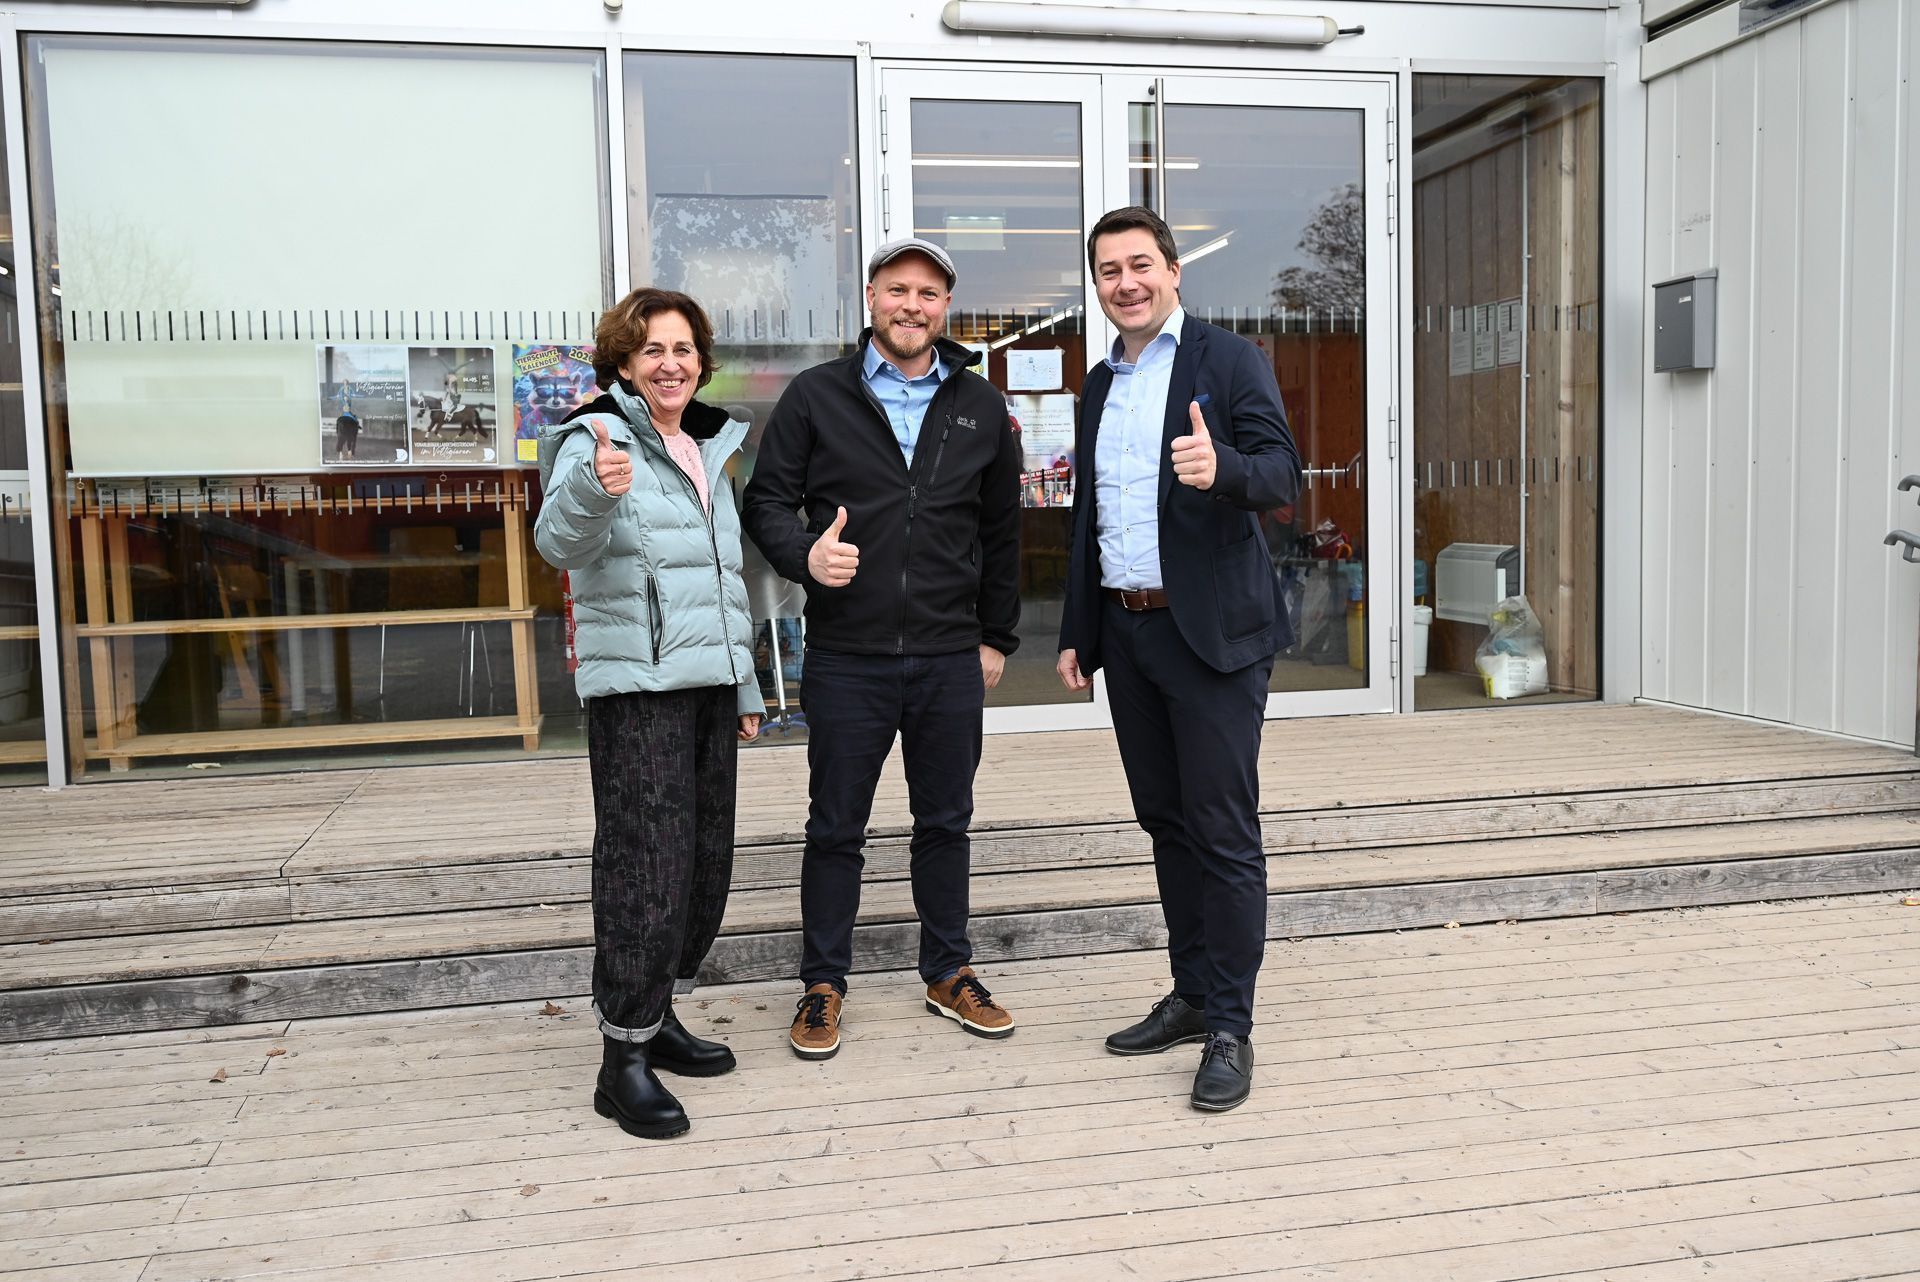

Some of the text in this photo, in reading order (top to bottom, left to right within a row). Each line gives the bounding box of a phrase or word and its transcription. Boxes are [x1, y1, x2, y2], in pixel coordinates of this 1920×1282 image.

[516, 350, 558, 364] TIERSCHUTZ
[570, 349, 593, 362] 2026
[522, 356, 560, 372] KALENDER
